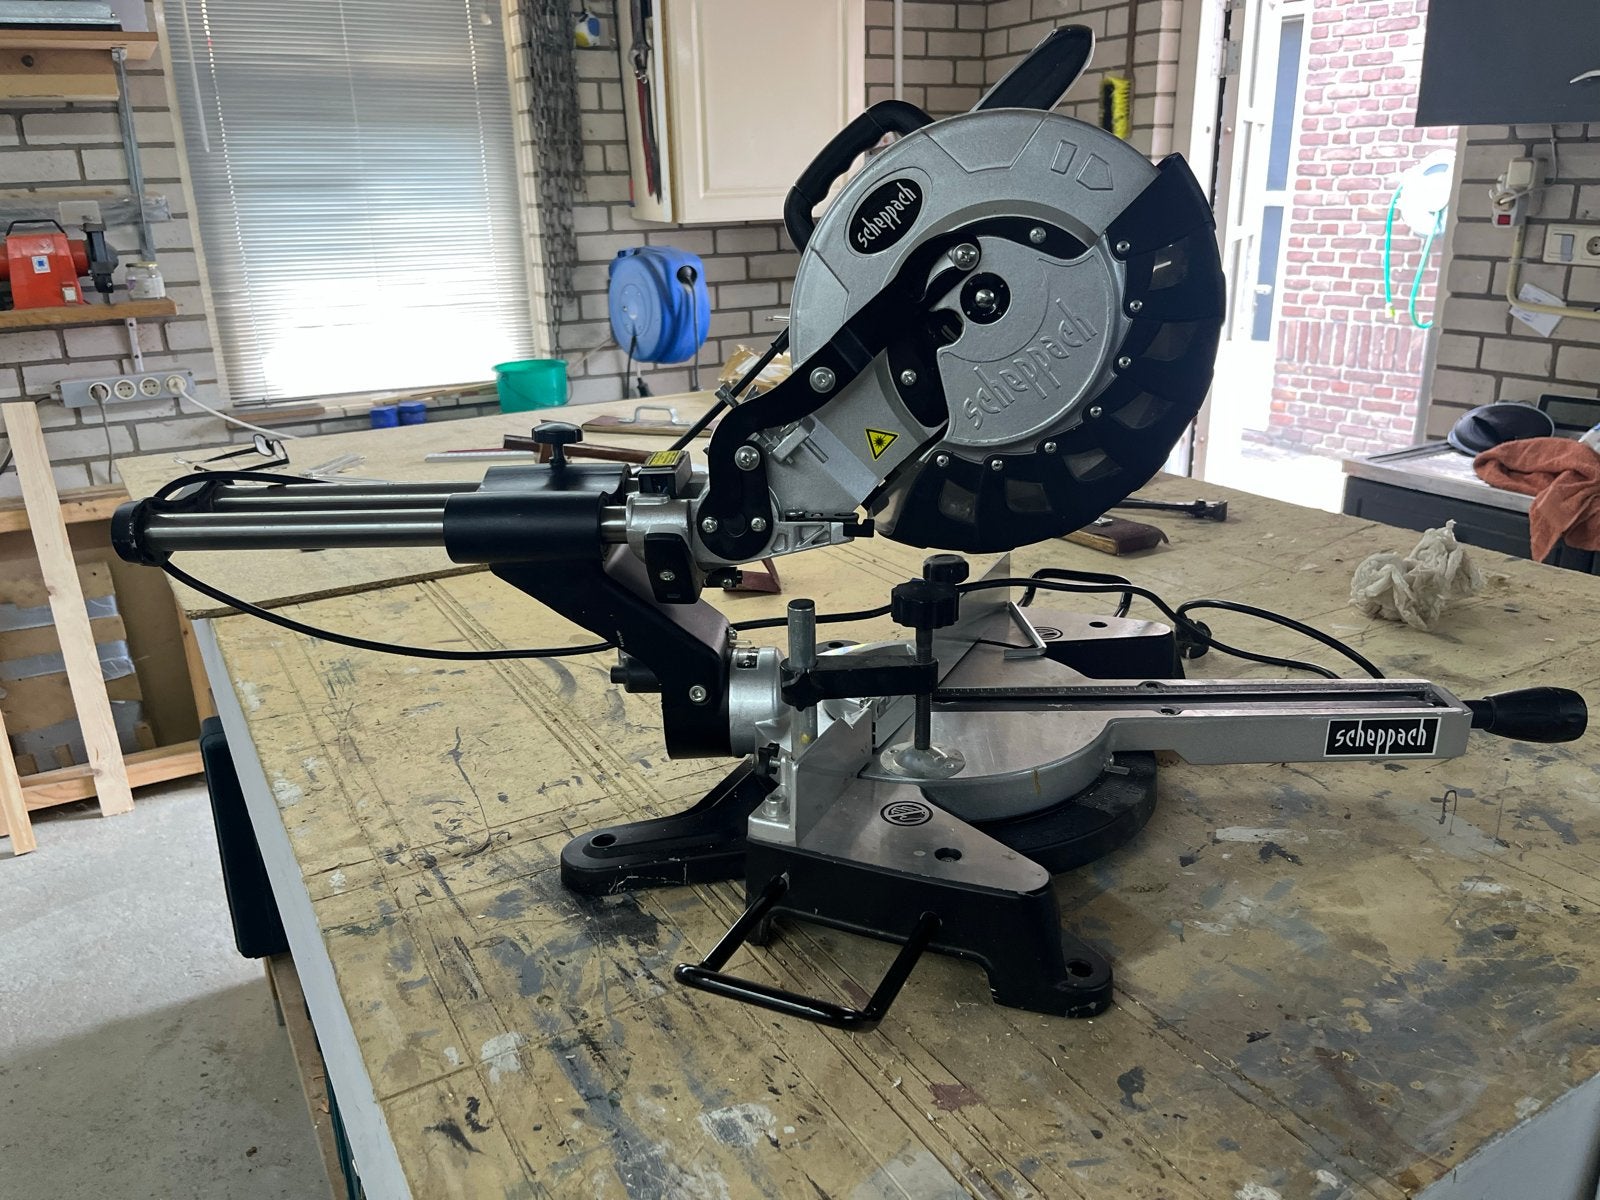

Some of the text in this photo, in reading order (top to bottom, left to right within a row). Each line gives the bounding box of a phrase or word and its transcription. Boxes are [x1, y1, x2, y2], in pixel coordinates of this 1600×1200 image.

[857, 182, 917, 248] scheppach
[963, 298, 1098, 431] scheppach
[1334, 719, 1427, 755] scheppach
